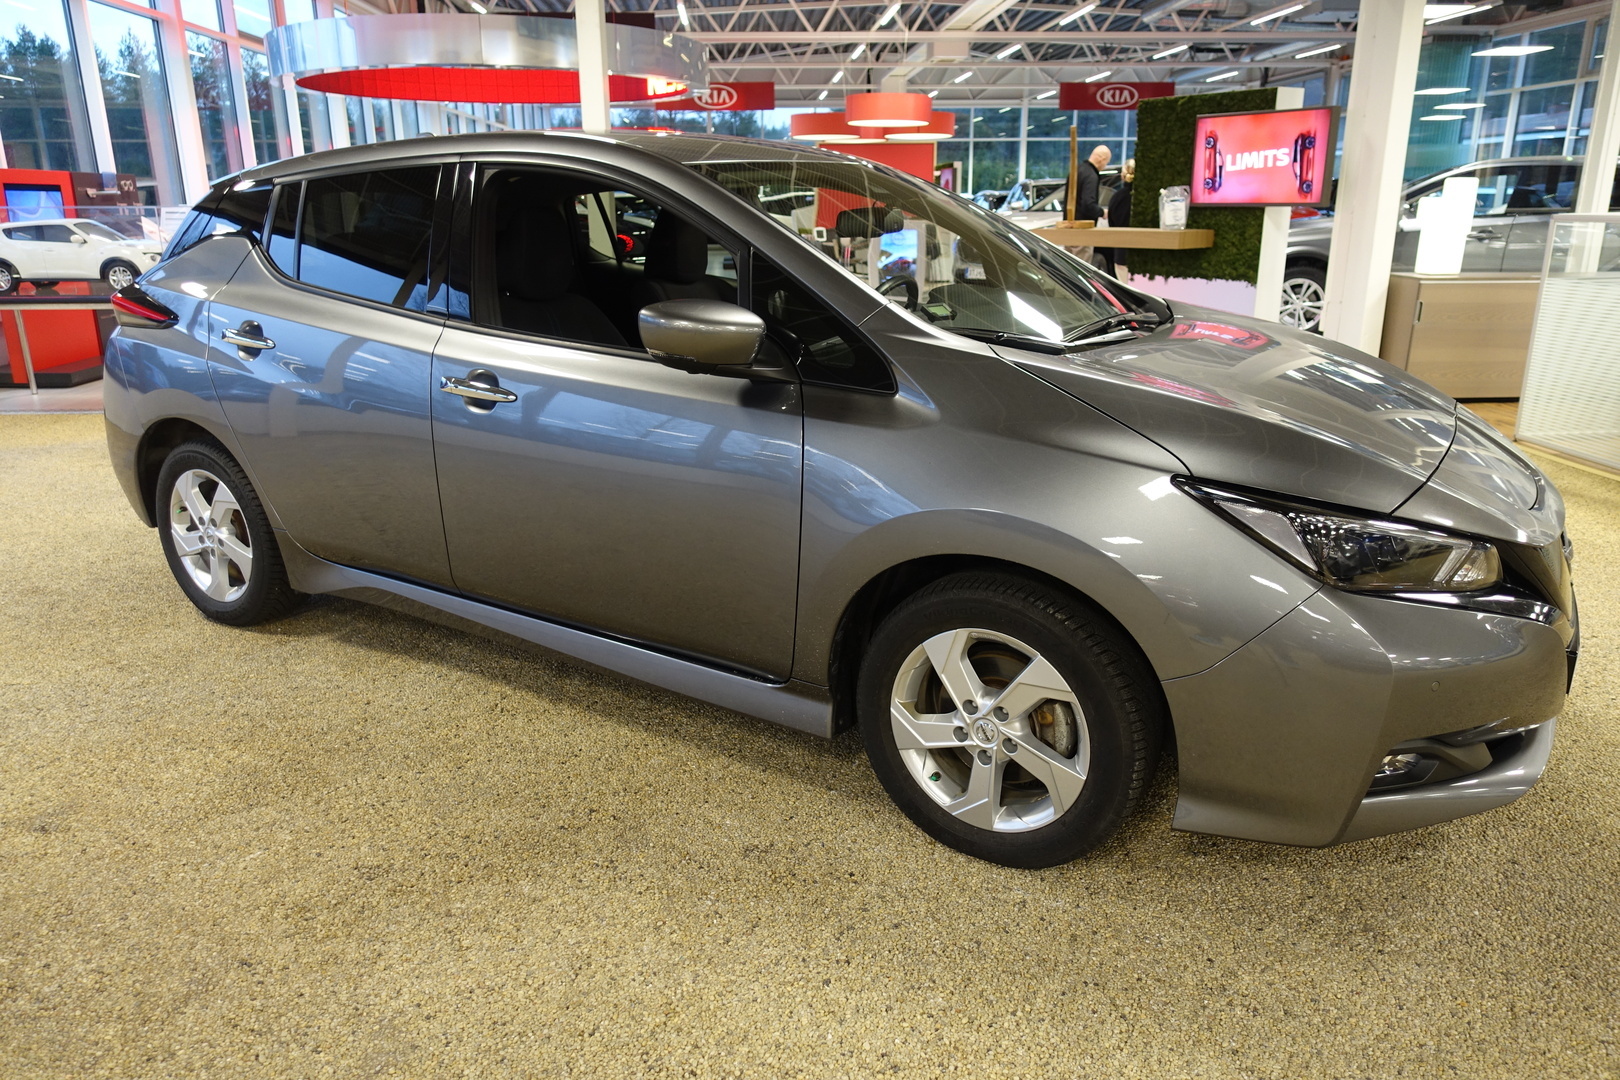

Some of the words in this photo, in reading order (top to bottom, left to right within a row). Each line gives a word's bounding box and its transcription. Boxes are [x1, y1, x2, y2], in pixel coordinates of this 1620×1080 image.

[701, 88, 730, 104] KIA
[1103, 89, 1131, 103] KIA
[1225, 147, 1290, 172] LIMITS
